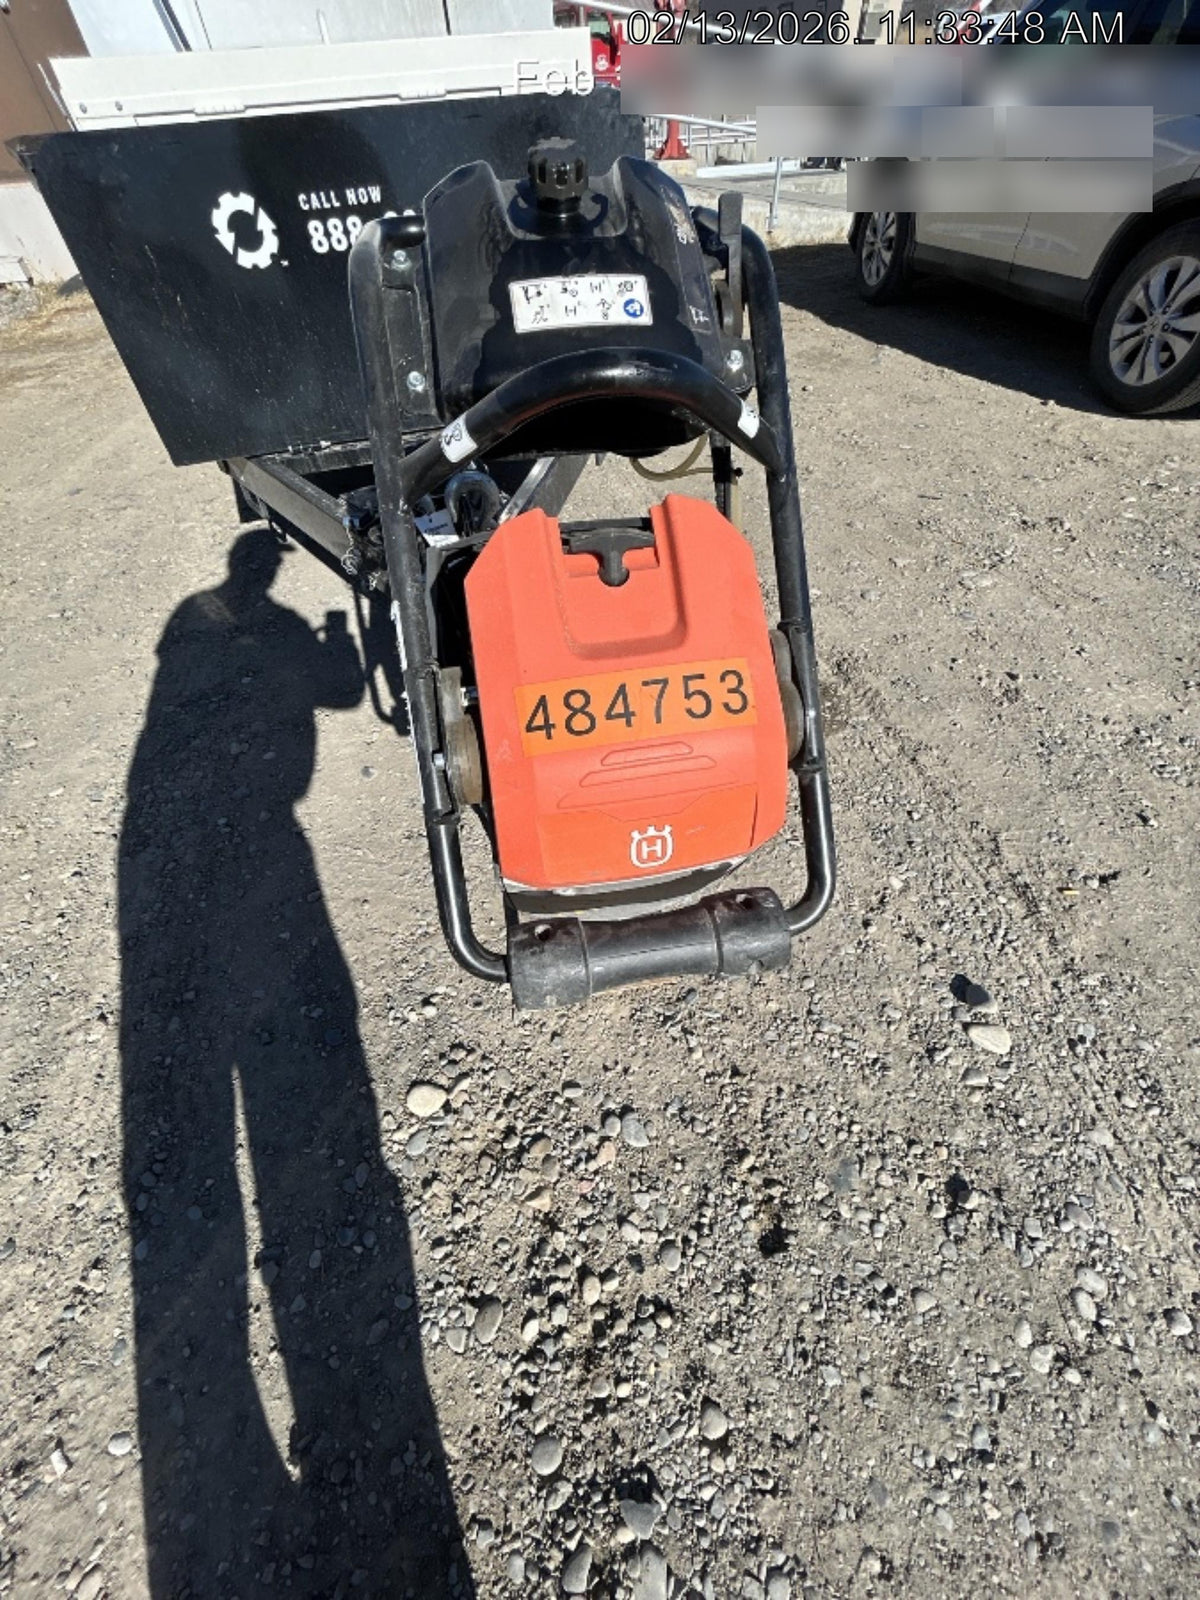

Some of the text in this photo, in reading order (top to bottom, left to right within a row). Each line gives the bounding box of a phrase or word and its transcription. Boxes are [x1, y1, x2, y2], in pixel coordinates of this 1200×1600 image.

[298, 184, 382, 211] CALL NOW
[525, 669, 749, 740] 484753
